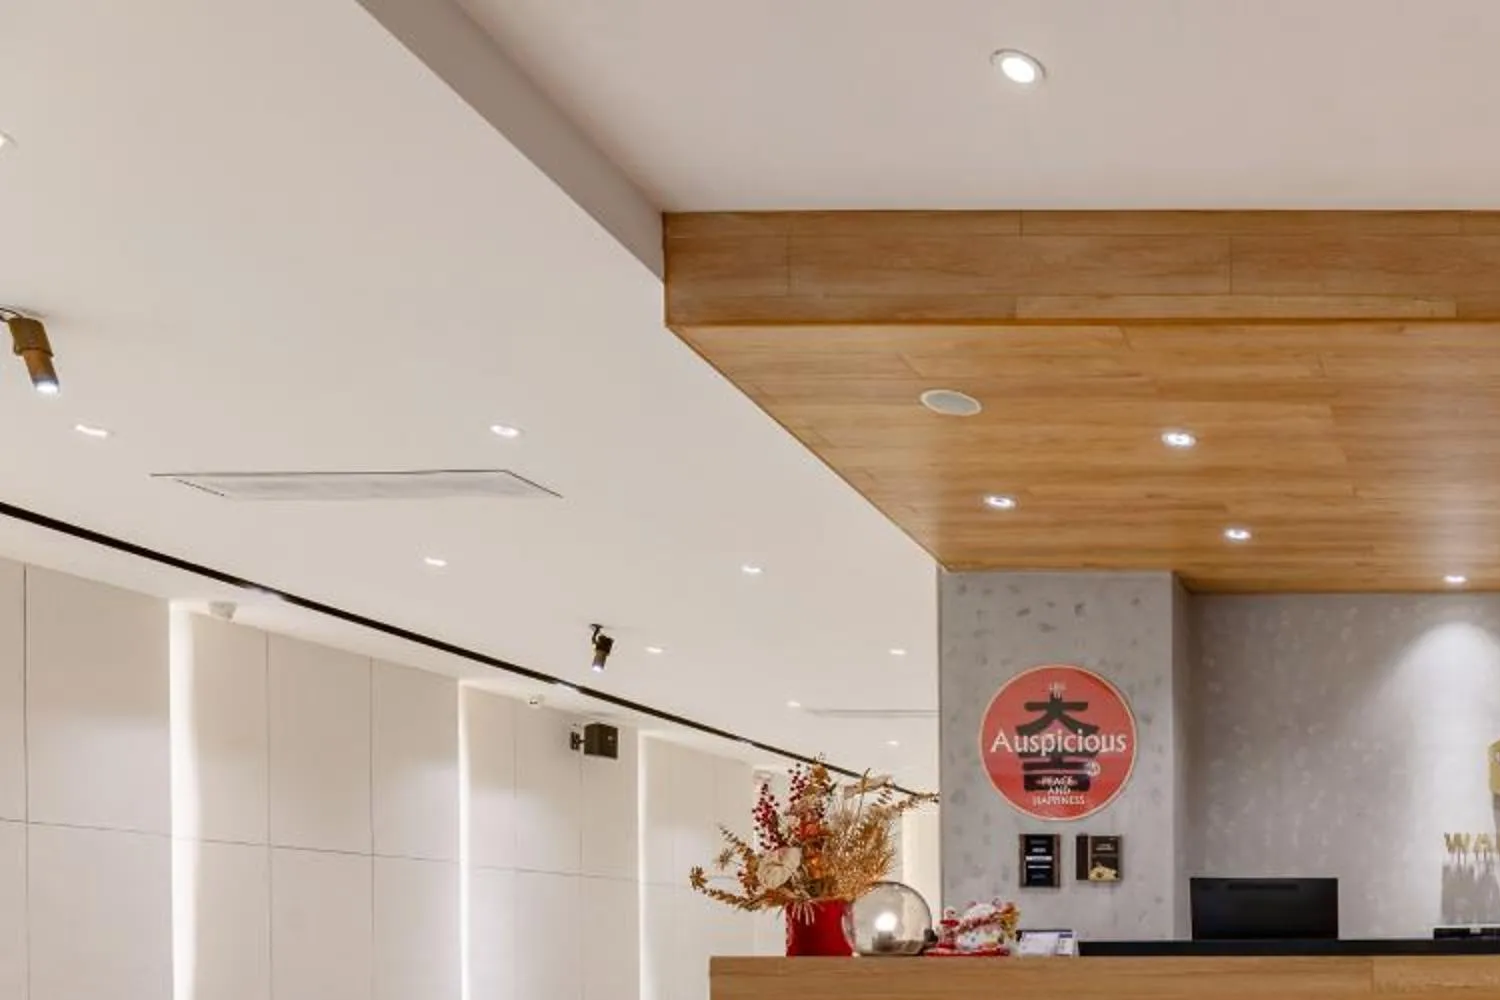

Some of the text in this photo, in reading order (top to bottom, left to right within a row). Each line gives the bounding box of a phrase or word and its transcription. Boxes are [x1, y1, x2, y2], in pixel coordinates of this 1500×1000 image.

[990, 728, 1127, 757] Auspicious
[1041, 776, 1073, 786] PEACE
[1048, 786, 1071, 795] AND
